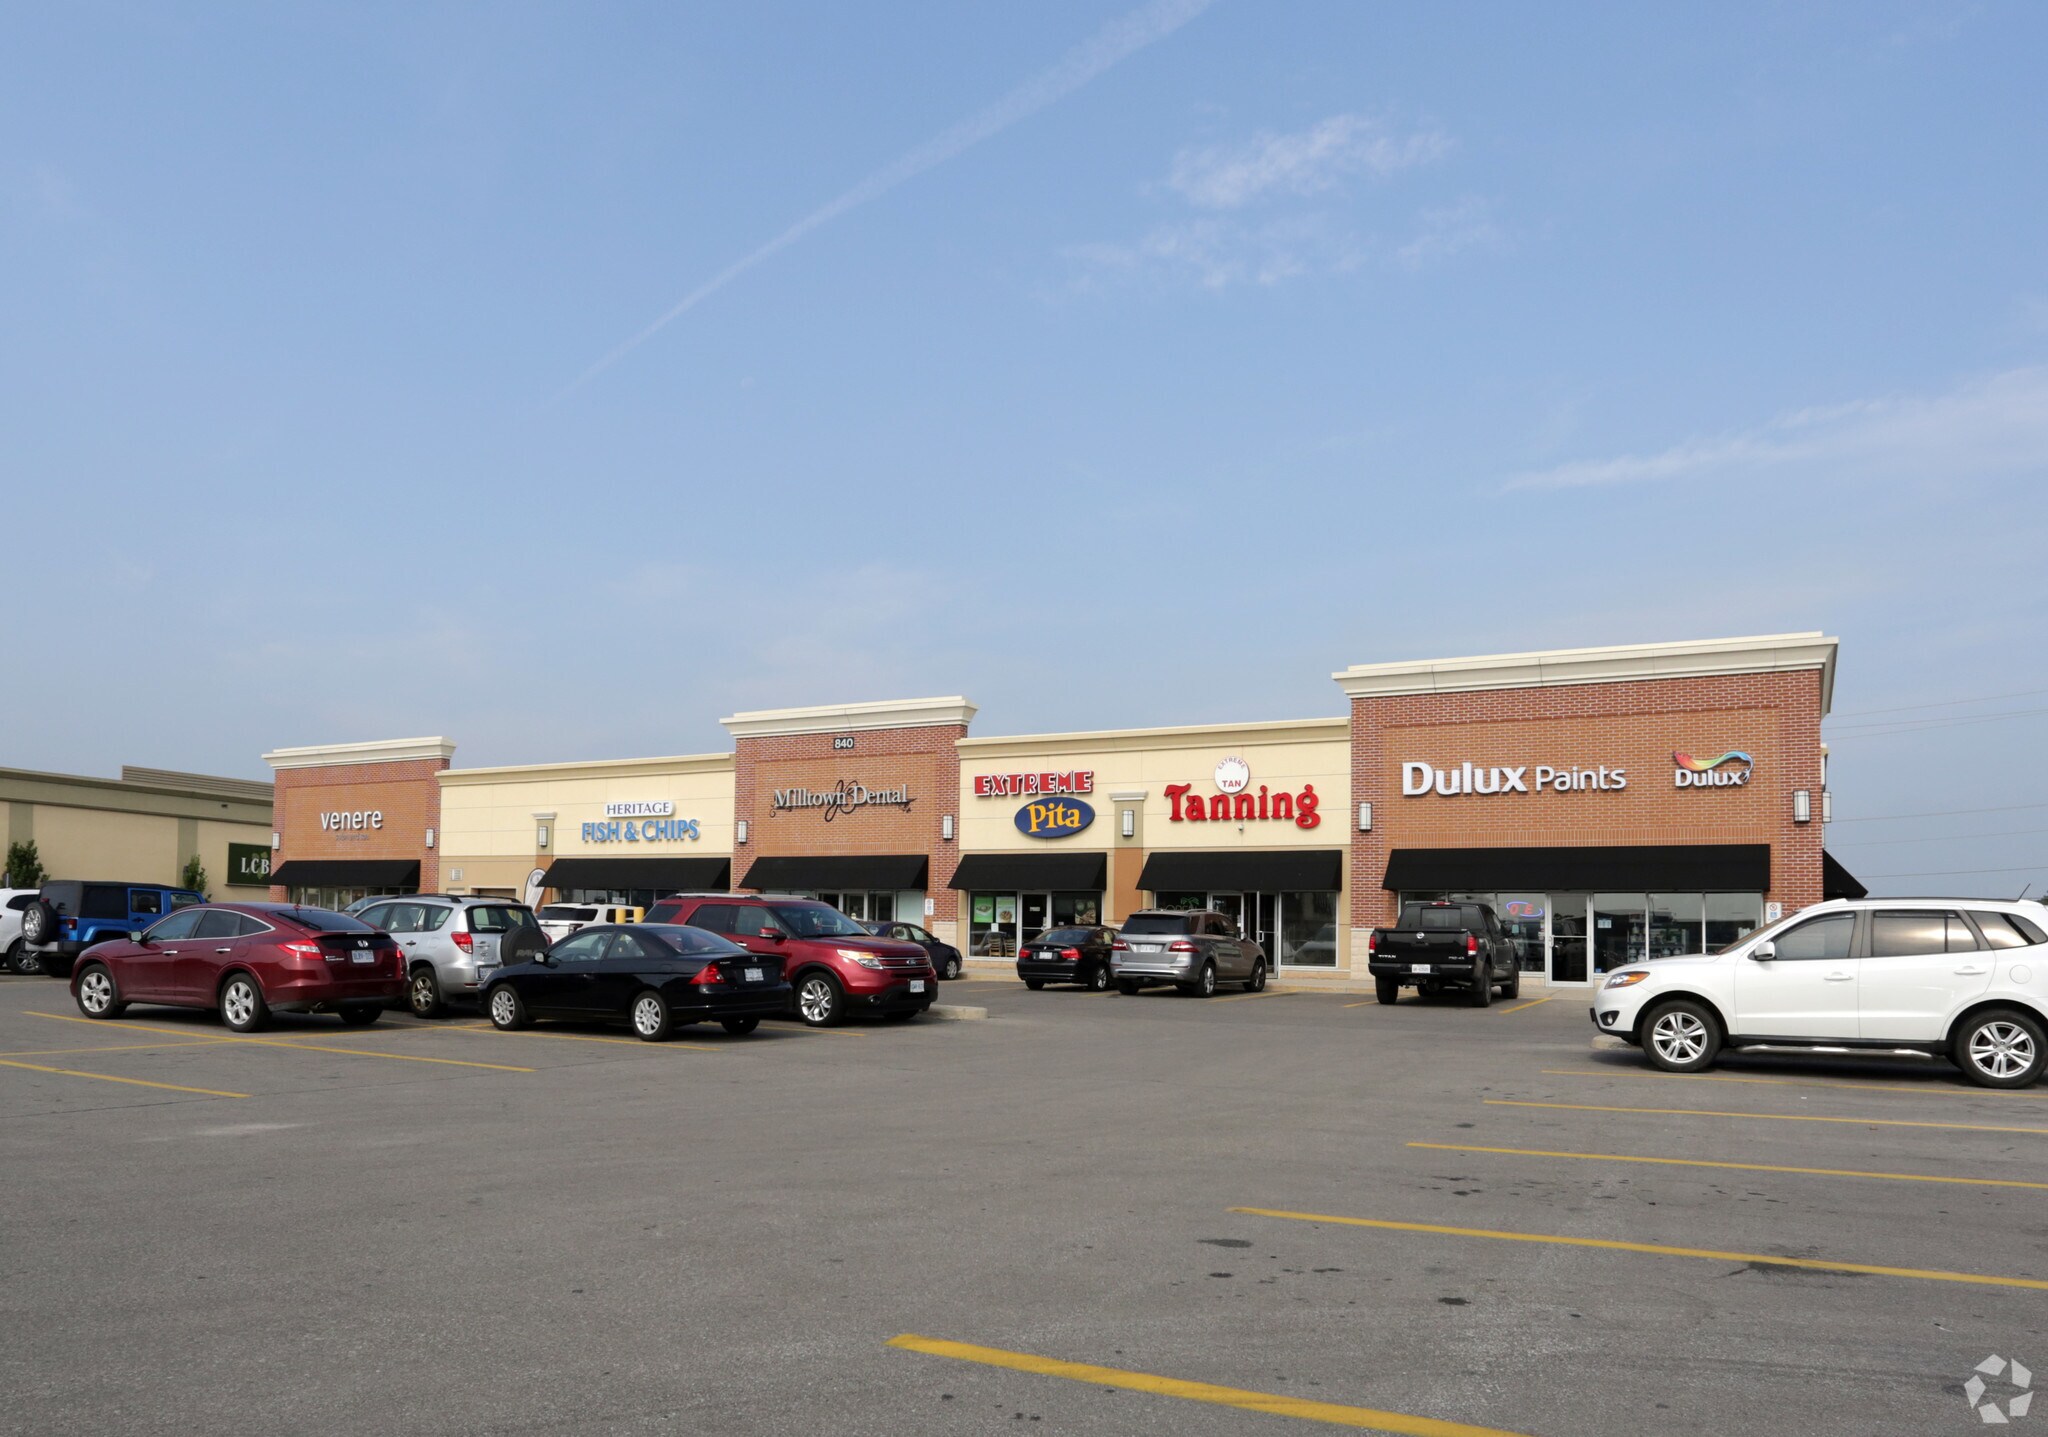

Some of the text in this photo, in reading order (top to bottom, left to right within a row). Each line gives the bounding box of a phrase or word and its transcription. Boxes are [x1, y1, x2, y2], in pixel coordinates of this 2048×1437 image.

[834, 737, 854, 749] 840
[1217, 756, 1246, 770] EXTREME
[973, 770, 1094, 797] EXTREME
[1222, 779, 1242, 788] TAN
[1402, 761, 1627, 796] Dulux Paints
[1674, 768, 1744, 787] Dulux
[774, 783, 908, 808] Milltown Dental
[1163, 782, 1322, 830] Tanning
[606, 801, 670, 815] HERITAGE
[1026, 801, 1082, 833] Pita
[320, 810, 384, 831] venere
[581, 818, 701, 842] FISH & CHIPS
[240, 857, 271, 875] LCB
